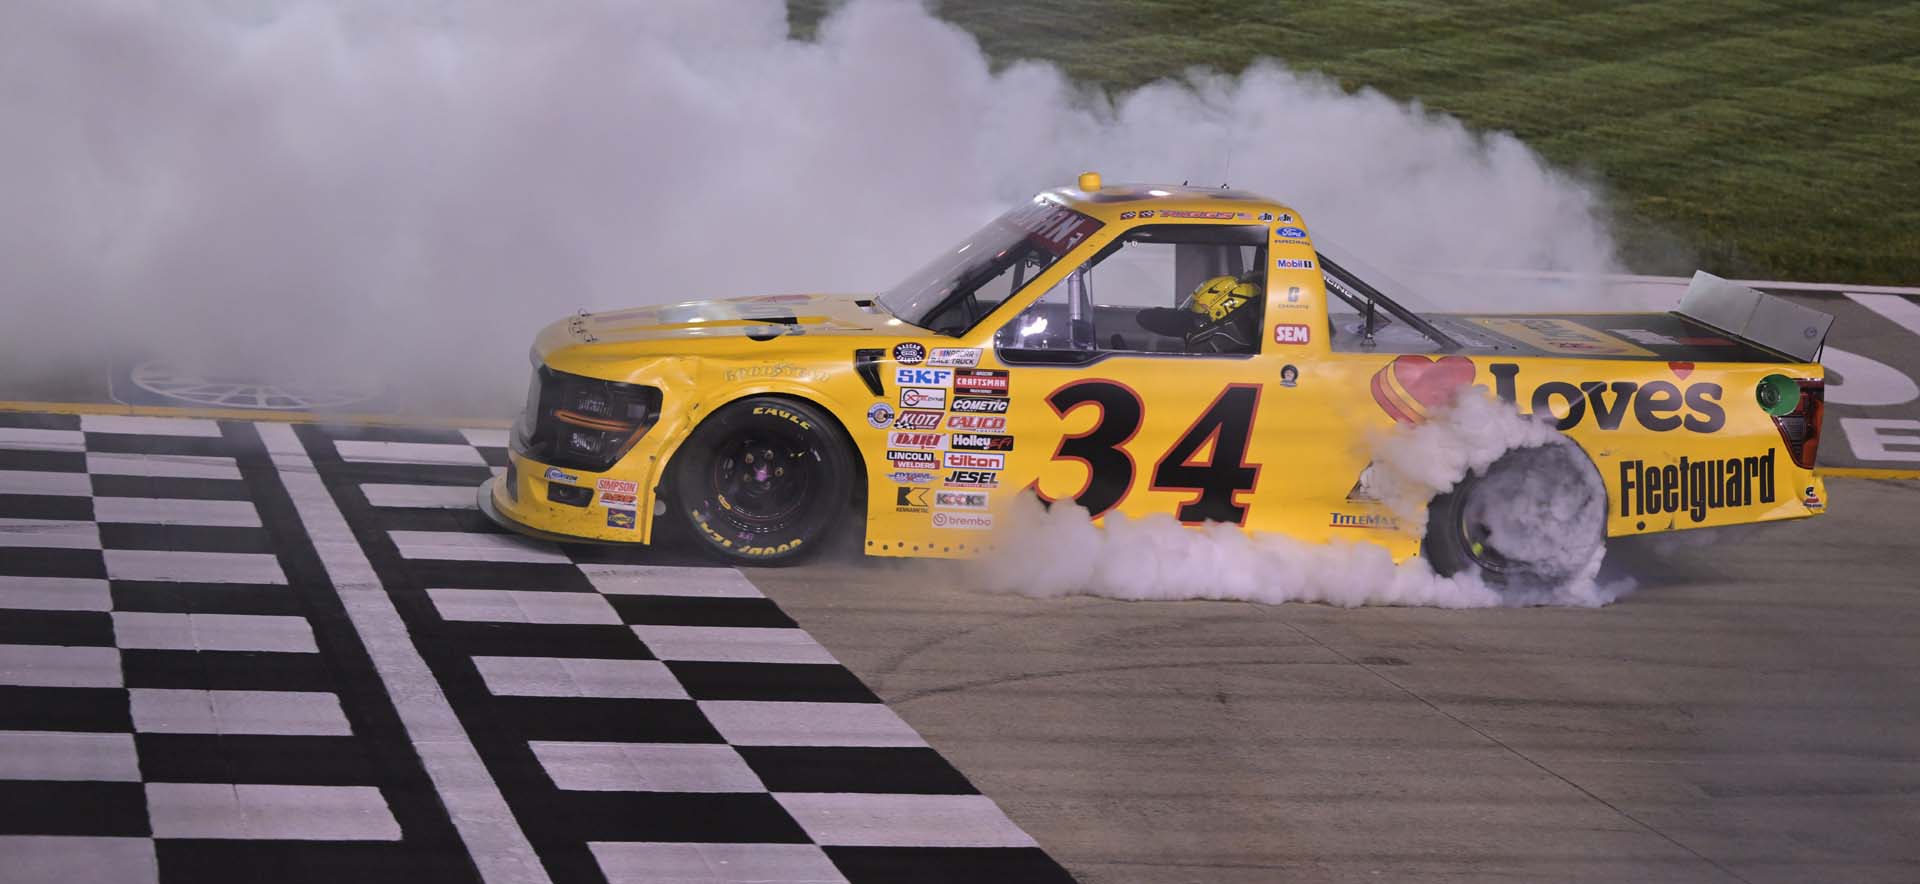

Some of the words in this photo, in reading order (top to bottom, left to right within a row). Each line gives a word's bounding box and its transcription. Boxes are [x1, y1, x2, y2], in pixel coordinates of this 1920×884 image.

[1277, 259, 1302, 268] Mobil
[1276, 326, 1308, 342] SEM
[951, 358, 976, 366] TRUCK
[897, 369, 951, 385] SKF
[956, 377, 1006, 388] CRAFTSMAN
[952, 399, 1008, 412] COMETIC
[752, 406, 812, 431] EAGLE
[902, 413, 941, 426] KLOTZ
[946, 416, 1006, 429] CALICO
[953, 434, 991, 449] Holley
[888, 451, 932, 461] LINCOLN
[1018, 377, 1264, 527] 34
[897, 461, 936, 469] WELDERS
[948, 454, 1000, 468] tilton
[944, 470, 999, 484] JESEL
[599, 479, 637, 493] SIMPSON
[1620, 448, 1775, 522] Fleetguard
[949, 515, 992, 527] brembo
